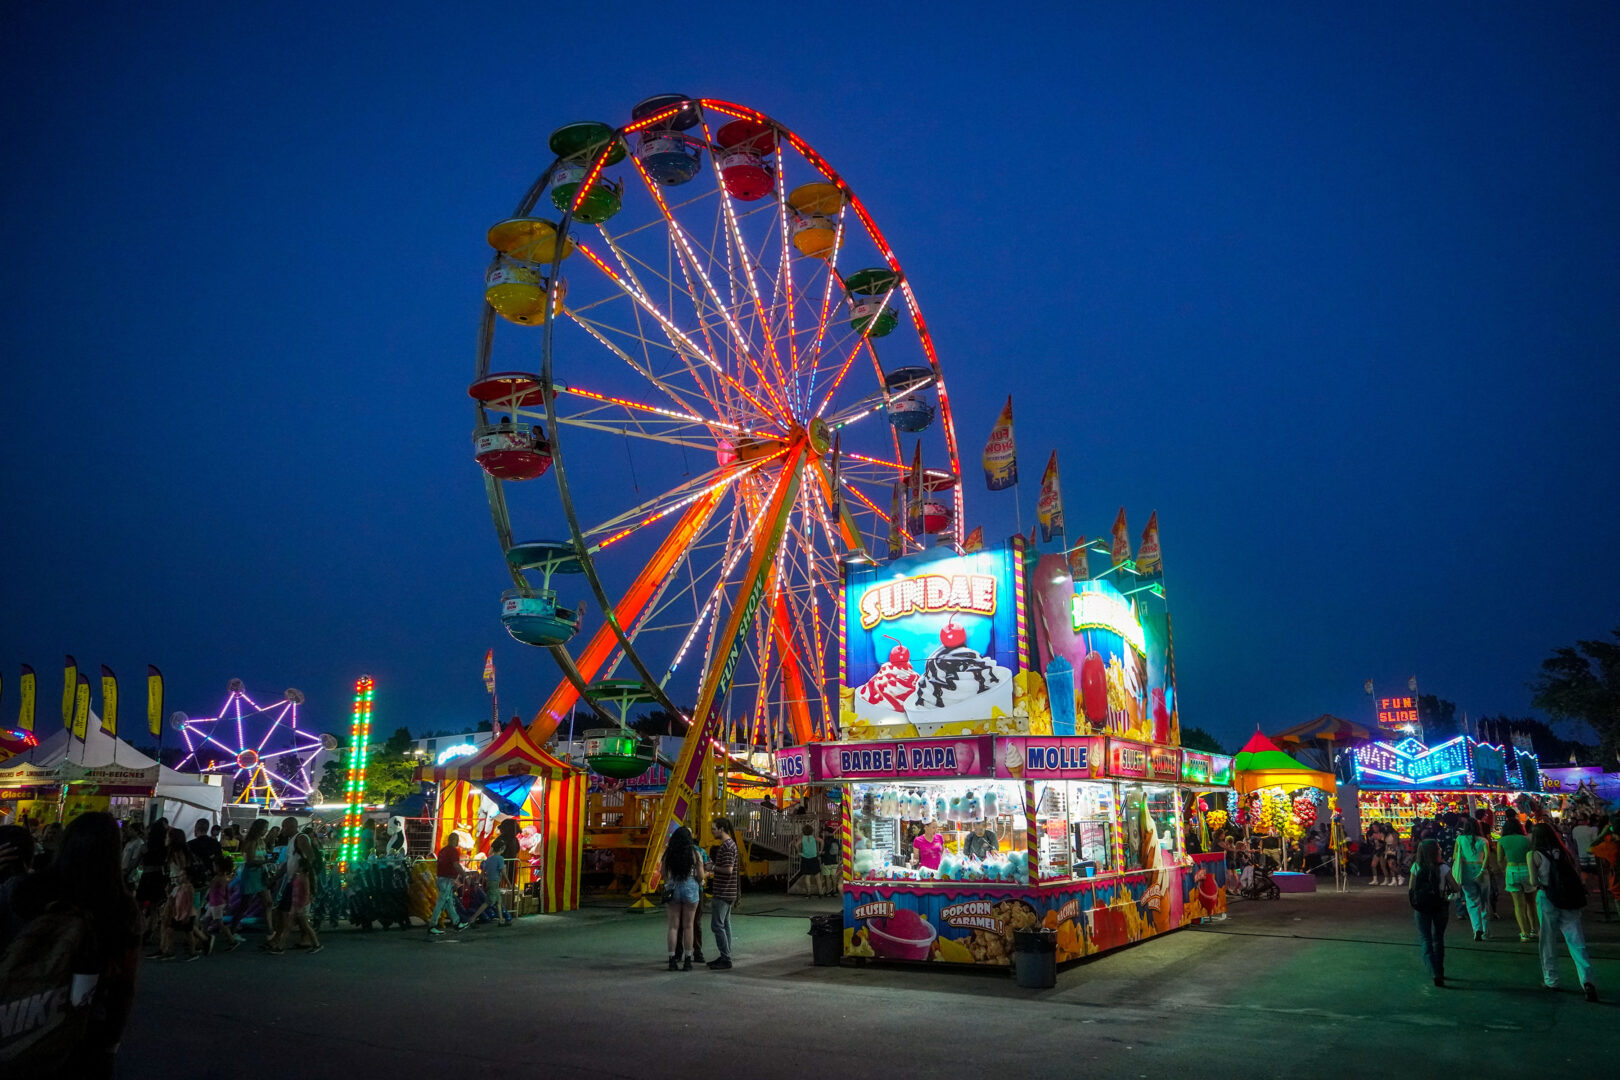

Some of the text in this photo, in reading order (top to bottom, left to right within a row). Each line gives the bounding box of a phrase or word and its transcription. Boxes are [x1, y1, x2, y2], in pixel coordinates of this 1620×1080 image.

[862, 576, 995, 627] SUNDAE
[719, 572, 763, 693] FUN SHOW
[1381, 697, 1412, 710] FUN
[1379, 710, 1418, 723] SLIDE
[840, 744, 957, 772] BARBE À PAPA
[1027, 745, 1089, 770] MOLLE
[1353, 744, 1404, 775] WATER
[1407, 755, 1432, 777] GUN
[855, 902, 888, 918] SLUSH
[942, 902, 992, 919] POPCORN
[949, 917, 997, 932] CARAMEL
